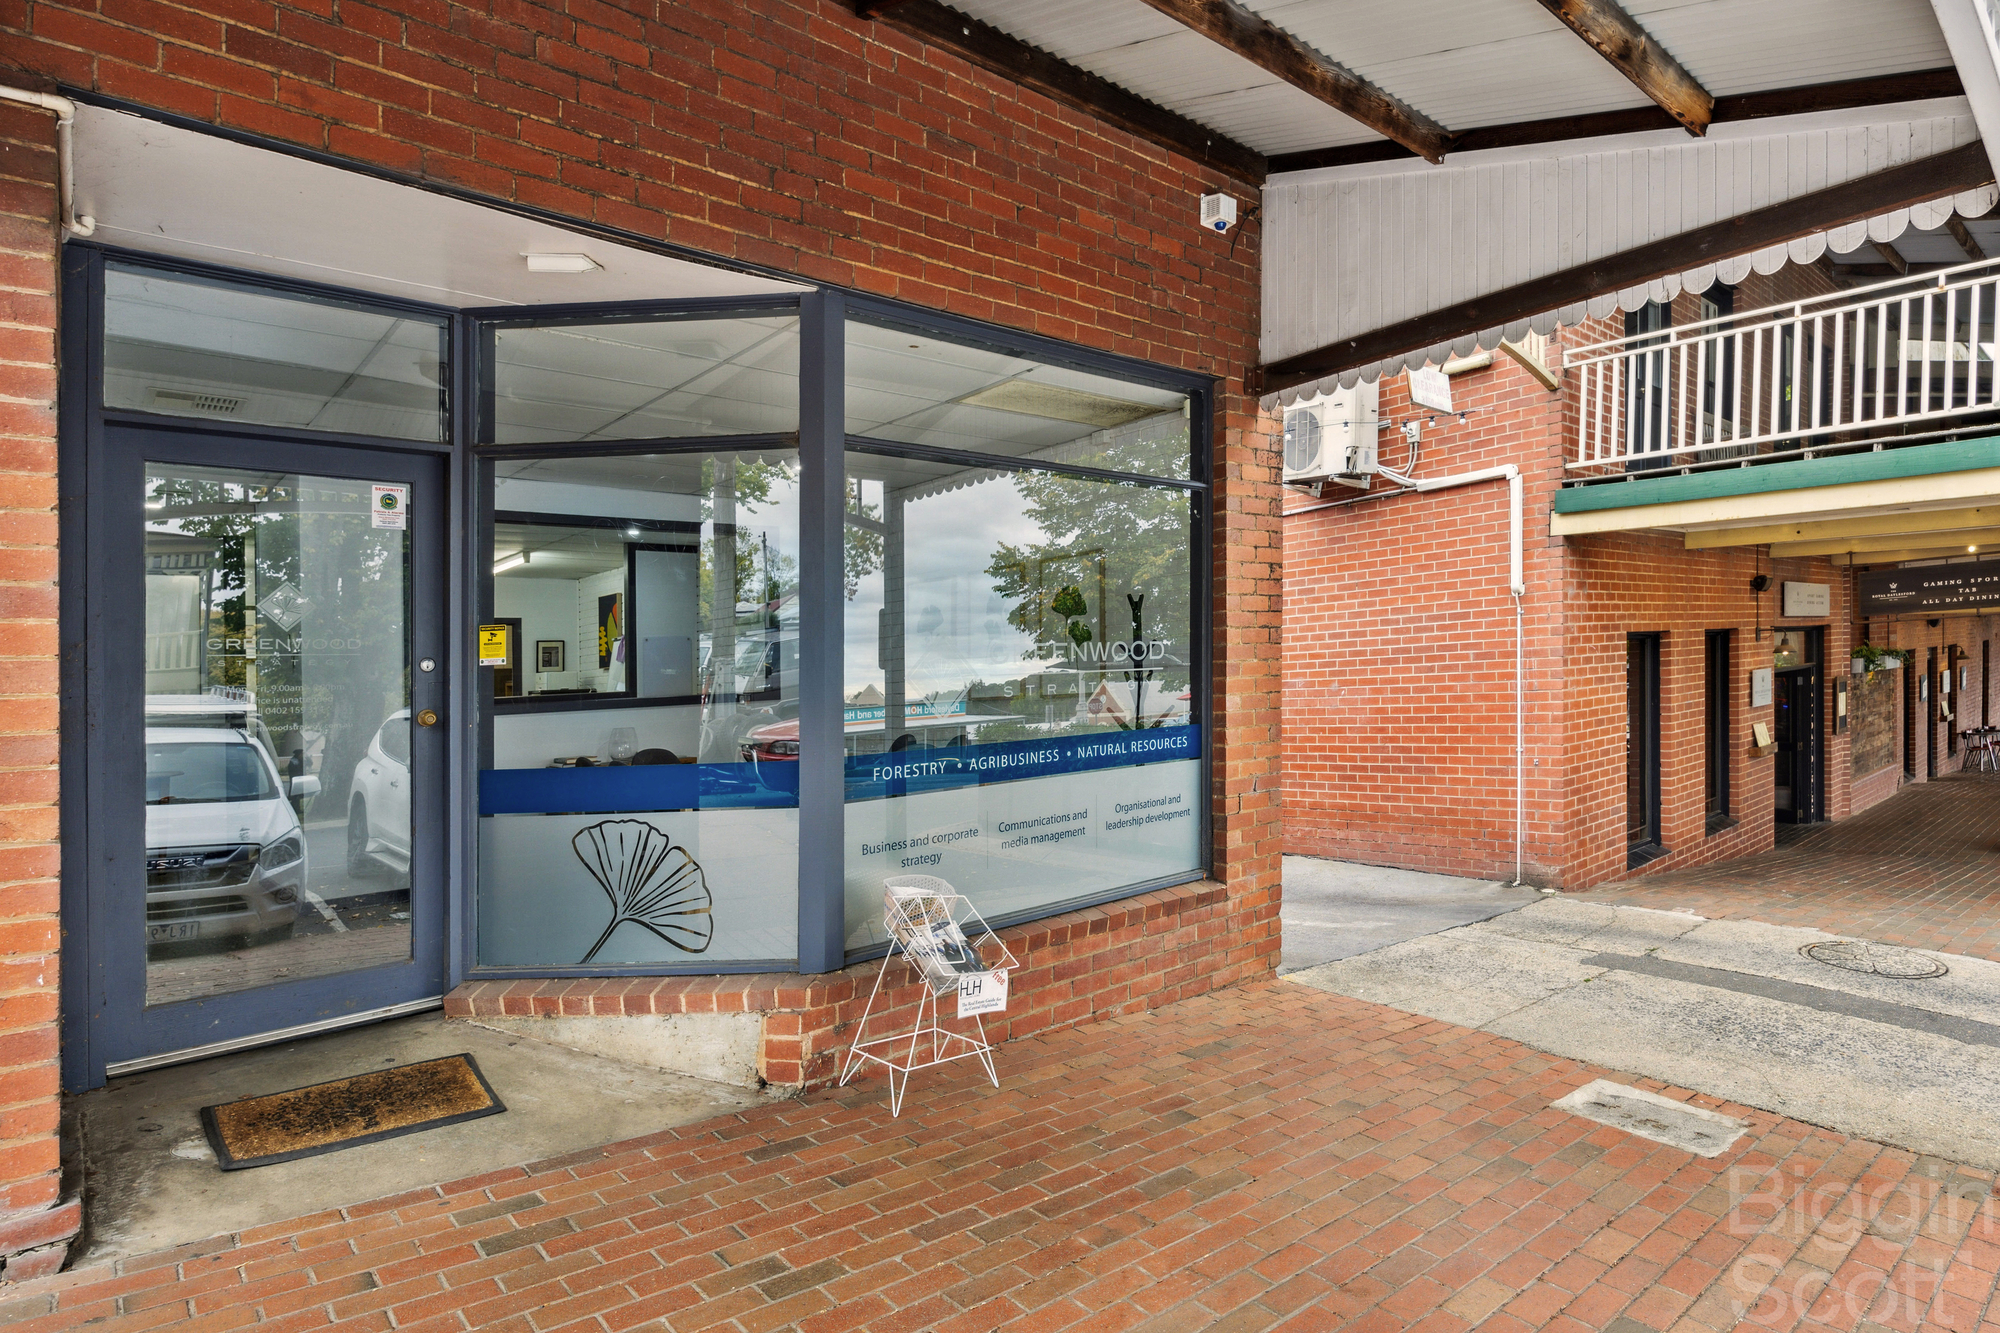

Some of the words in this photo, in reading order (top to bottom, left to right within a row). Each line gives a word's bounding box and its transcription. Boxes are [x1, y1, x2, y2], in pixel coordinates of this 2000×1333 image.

[1923, 578, 1963, 588] GAMING
[1970, 576, 2000, 584] SPOR
[1969, 593, 2000, 602] DININ
[206, 638, 362, 650] GREENWOOD
[217, 659, 352, 668] STRATEGY
[271, 685, 302, 693] 9.00am
[282, 696, 334, 704] unattended
[265, 707, 288, 715] 0402
[873, 761, 947, 781] FORESTRY
[969, 749, 1060, 771] AGRIBUSINESS
[1077, 743, 1128, 758] NATURAL
[1131, 736, 1188, 752] RESOURCES
[1114, 796, 1167, 815] Organisational
[1167, 793, 1182, 805] and
[998, 813, 1070, 833] Communications
[1072, 808, 1088, 821] and
[1105, 816, 1144, 831] leadership
[1145, 808, 1191, 824] development
[862, 840, 908, 856] Business
[909, 834, 930, 848] and
[931, 828, 979, 844] corporate
[1001, 835, 1029, 850] media
[1030, 826, 1086, 845] management
[901, 852, 943, 868] strategy
